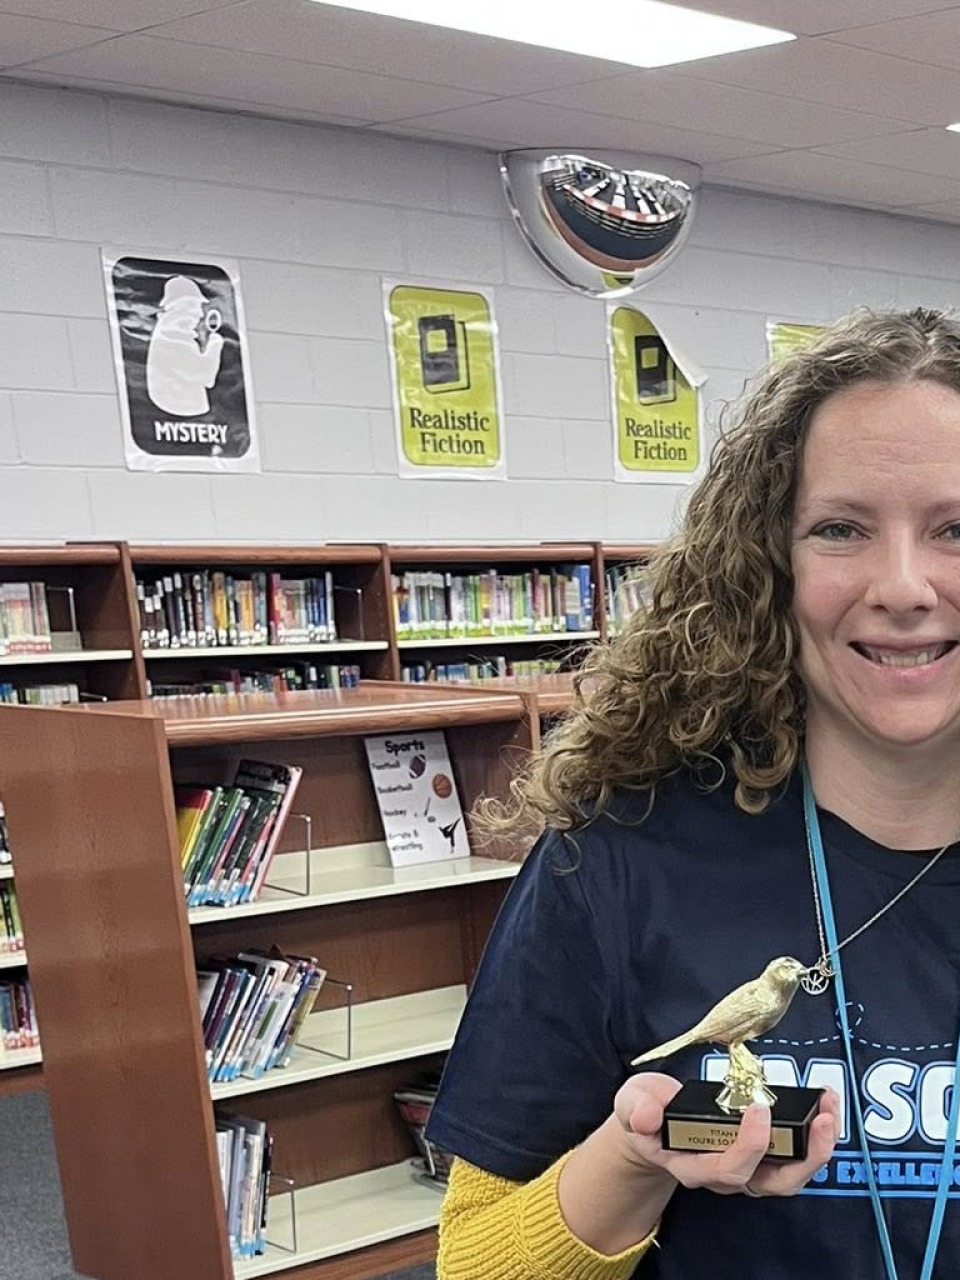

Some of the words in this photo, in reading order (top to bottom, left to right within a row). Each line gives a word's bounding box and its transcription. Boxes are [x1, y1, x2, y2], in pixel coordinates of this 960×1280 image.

[409, 407, 490, 431] Realistic
[625, 417, 692, 440] Realistic
[154, 420, 228, 444] MYSTERY
[420, 432, 486, 455] Fiction
[634, 440, 688, 461] Fiction
[384, 739, 426, 756] Sports
[710, 1129, 734, 1137] TITAN
